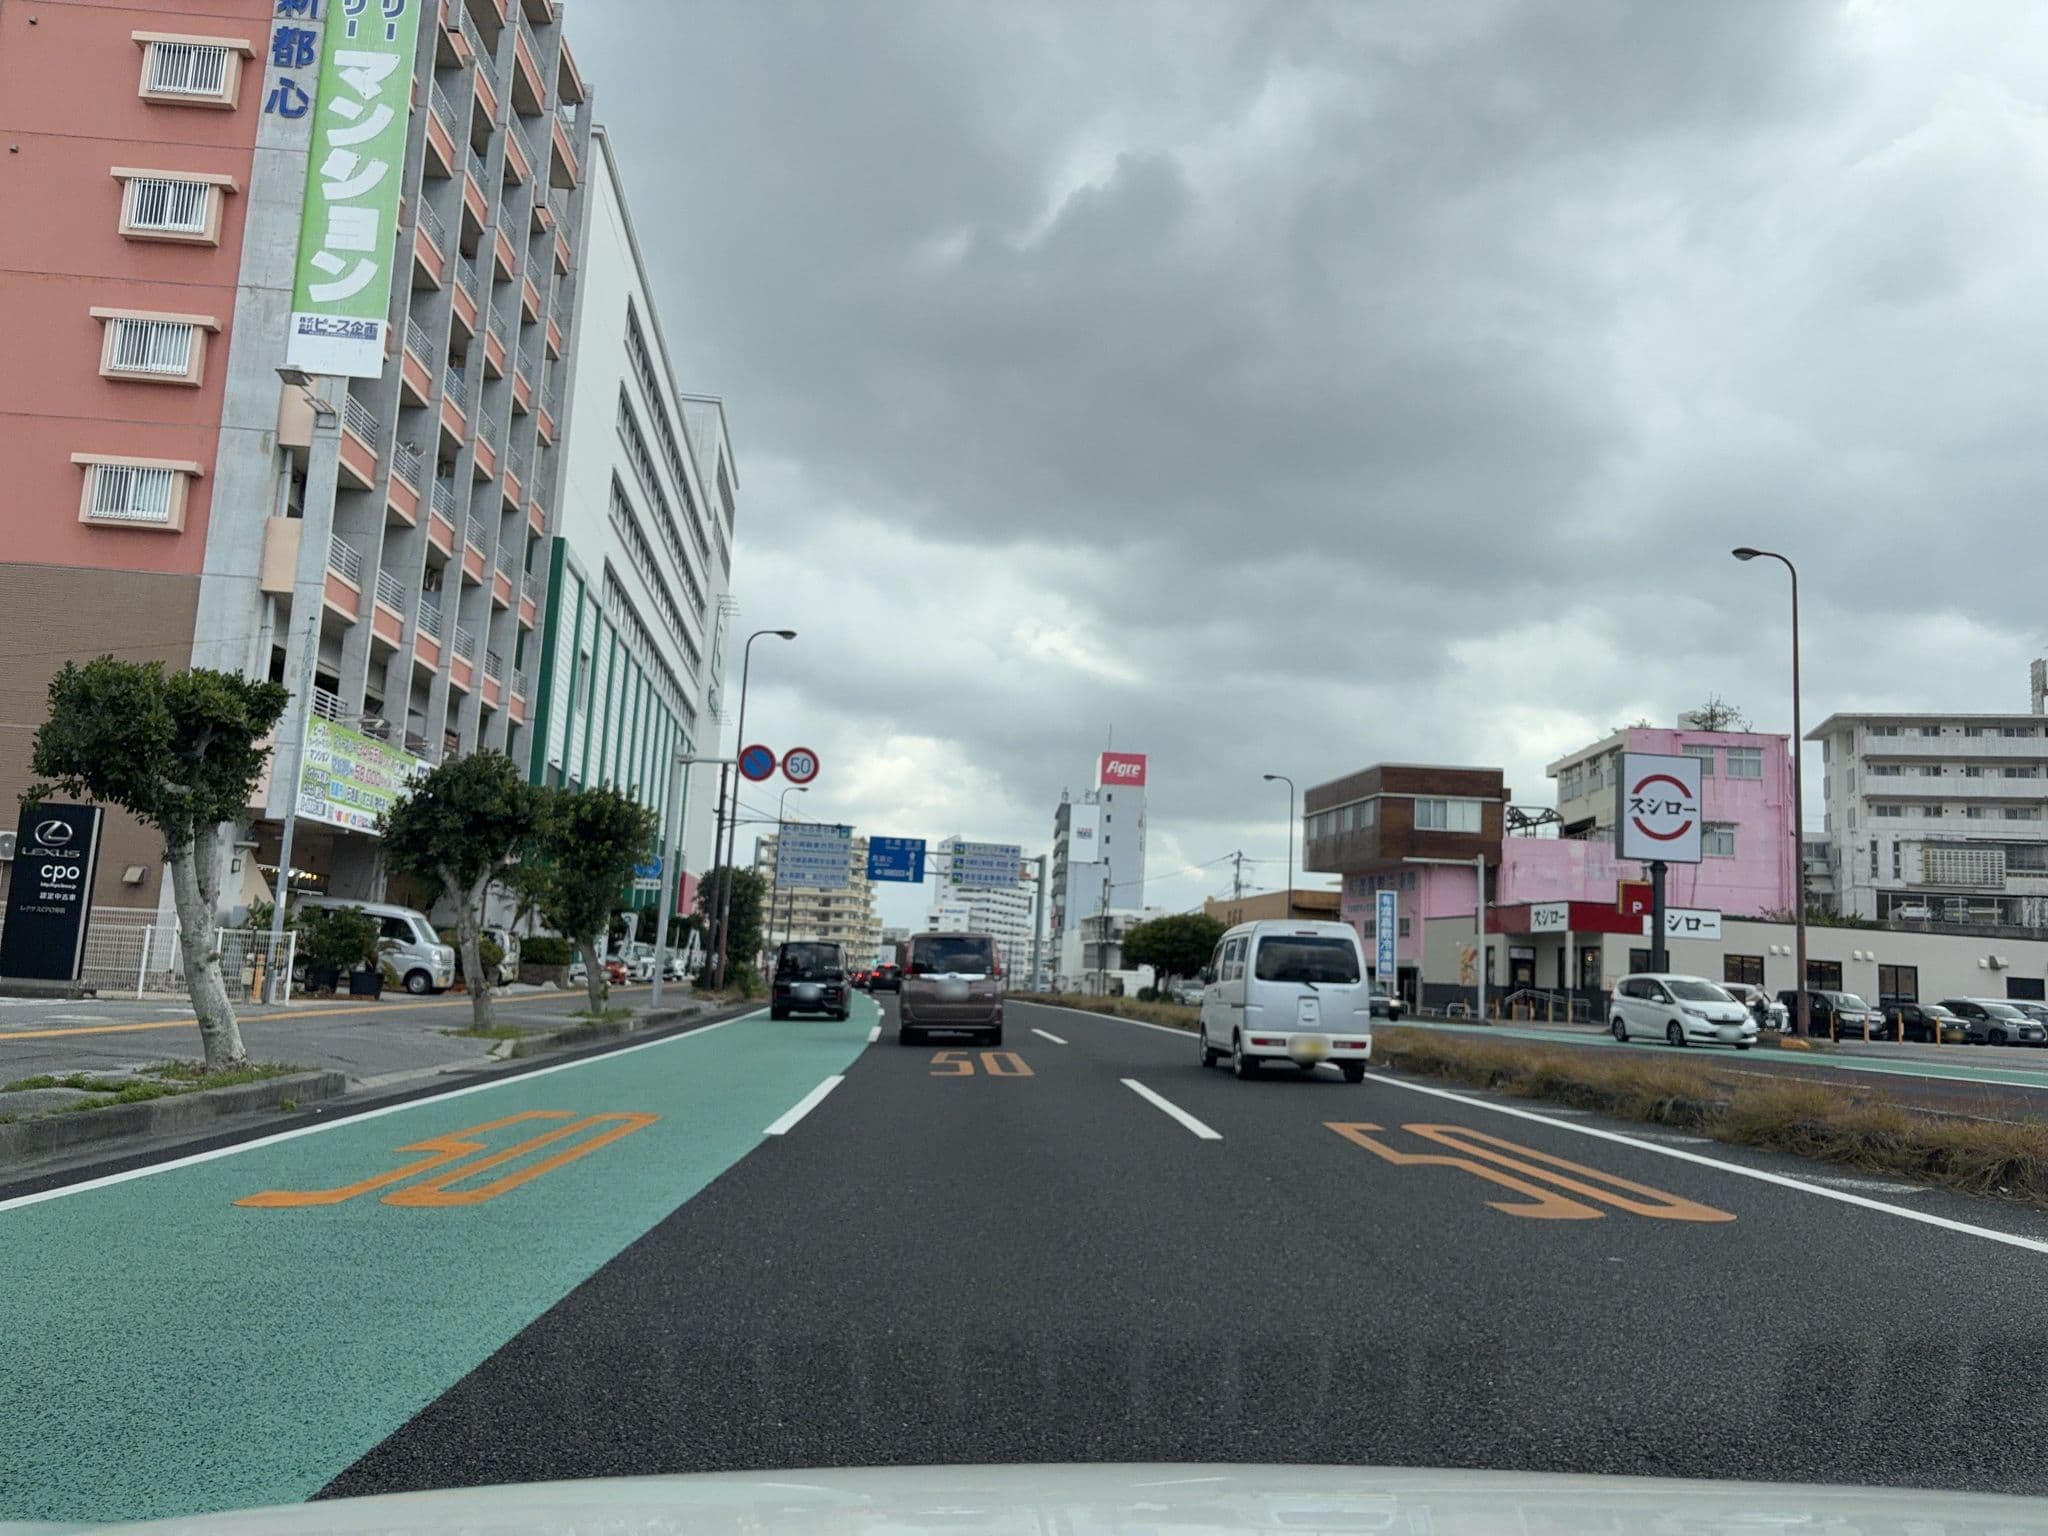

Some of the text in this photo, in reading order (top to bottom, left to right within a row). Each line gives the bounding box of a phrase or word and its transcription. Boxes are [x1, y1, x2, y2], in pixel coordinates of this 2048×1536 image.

[309, 50, 400, 303] マンション
[790, 757, 811, 774] 50
[1106, 760, 1141, 777] Agre
[1627, 797, 1697, 815] スシロー
[21, 847, 80, 858] LEXUS
[41, 864, 80, 882] cpo
[1632, 901, 1643, 914] P
[1533, 910, 1567, 926] スシロー
[1650, 914, 1716, 932] シロー
[930, 1051, 1035, 1077] 50
[235, 1110, 658, 1207] 50
[1323, 1122, 1738, 1222] 50
